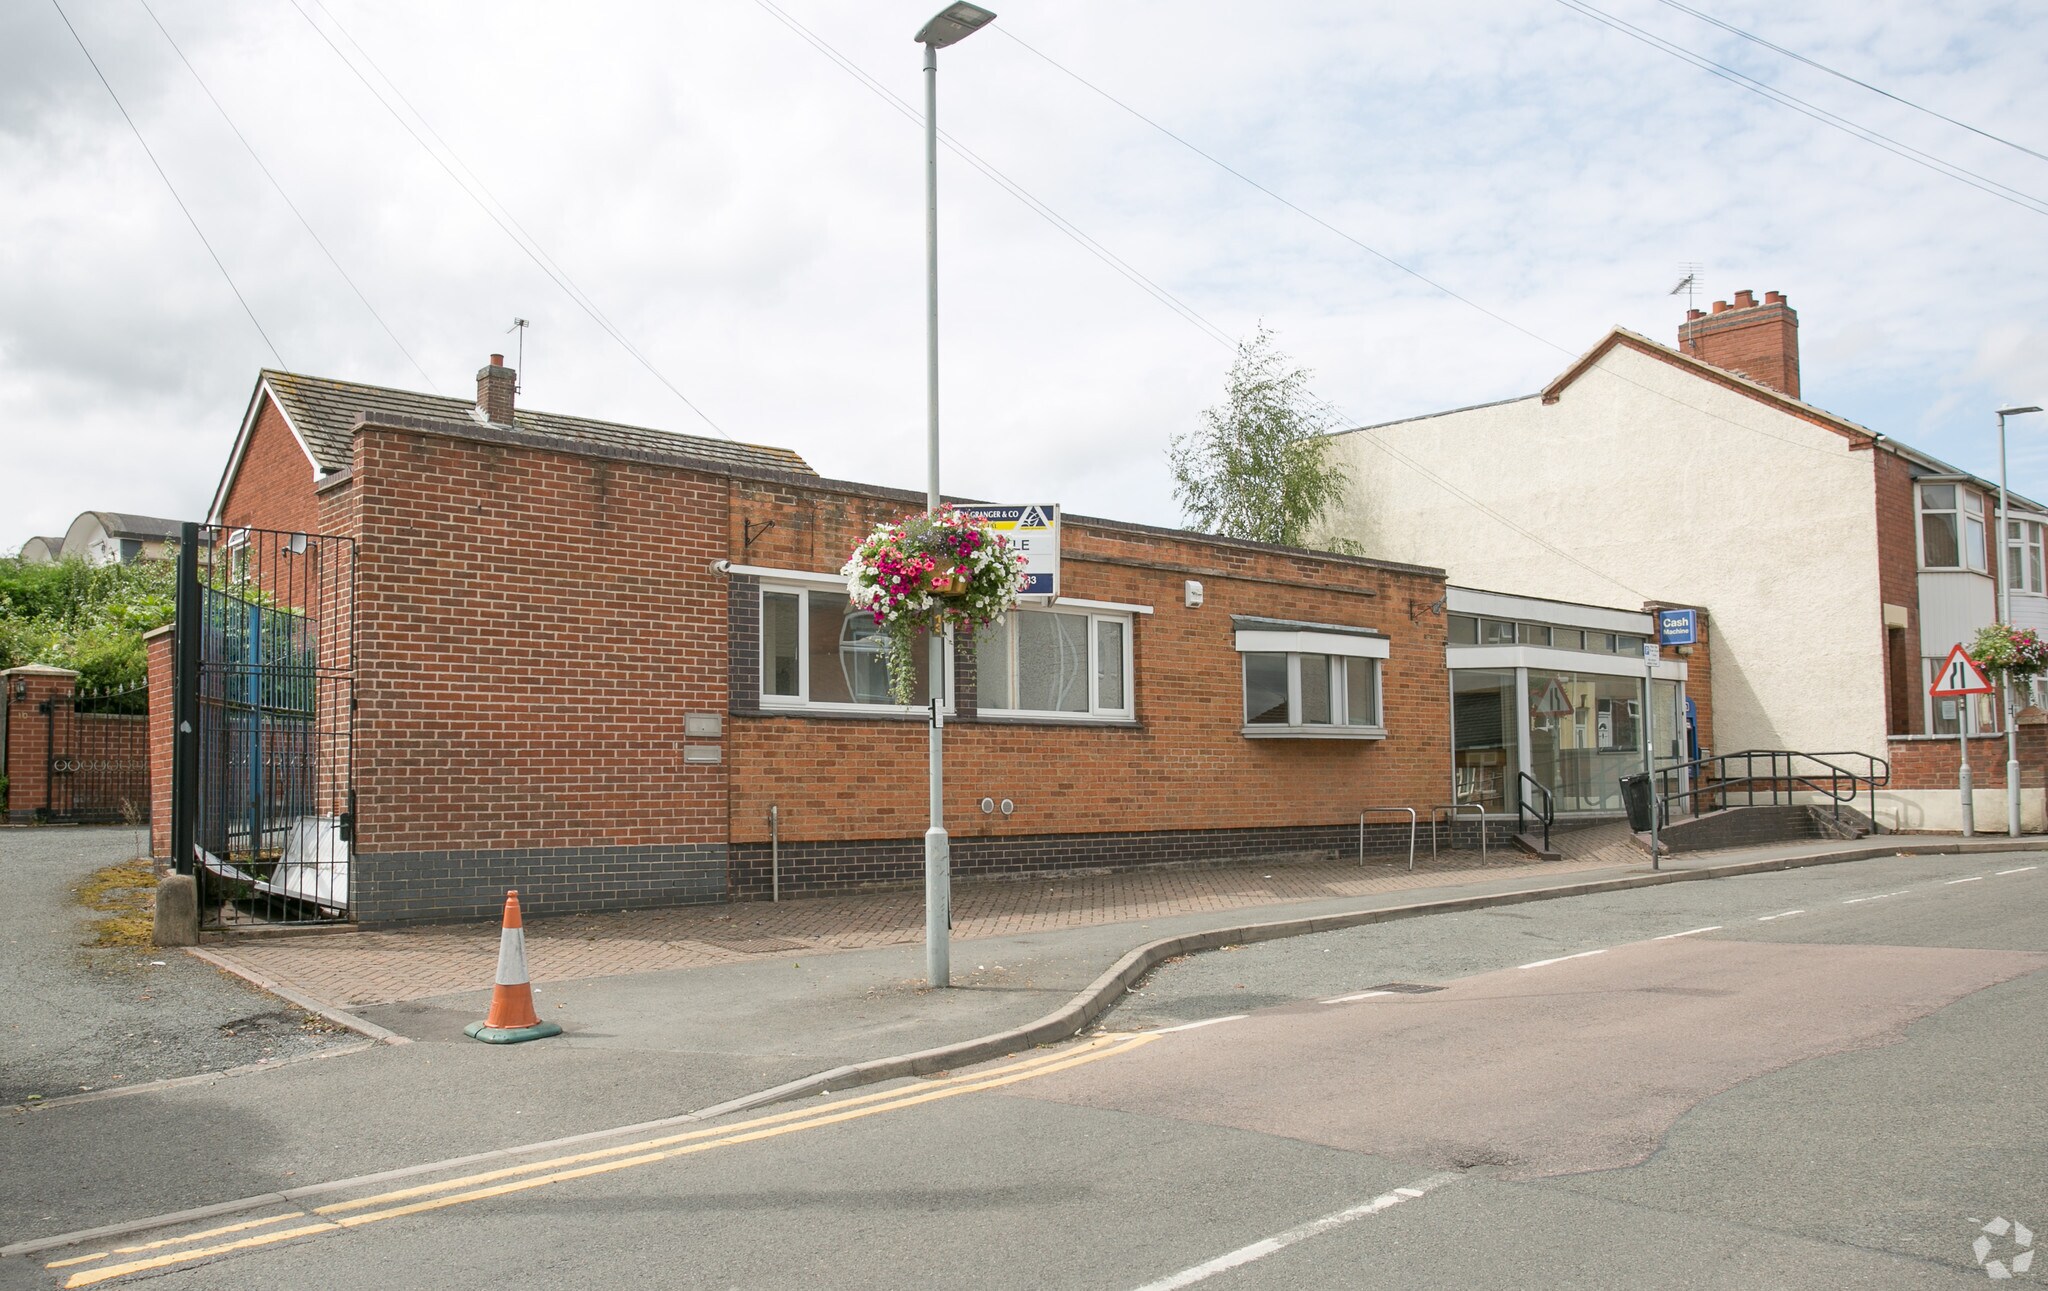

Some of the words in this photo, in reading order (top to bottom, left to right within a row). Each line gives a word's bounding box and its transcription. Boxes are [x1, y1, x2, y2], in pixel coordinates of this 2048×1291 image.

[970, 510, 1001, 518] GRANGER
[1008, 510, 1019, 518] CO
[1013, 539, 1030, 551] LE
[1663, 617, 1689, 628] Cash
